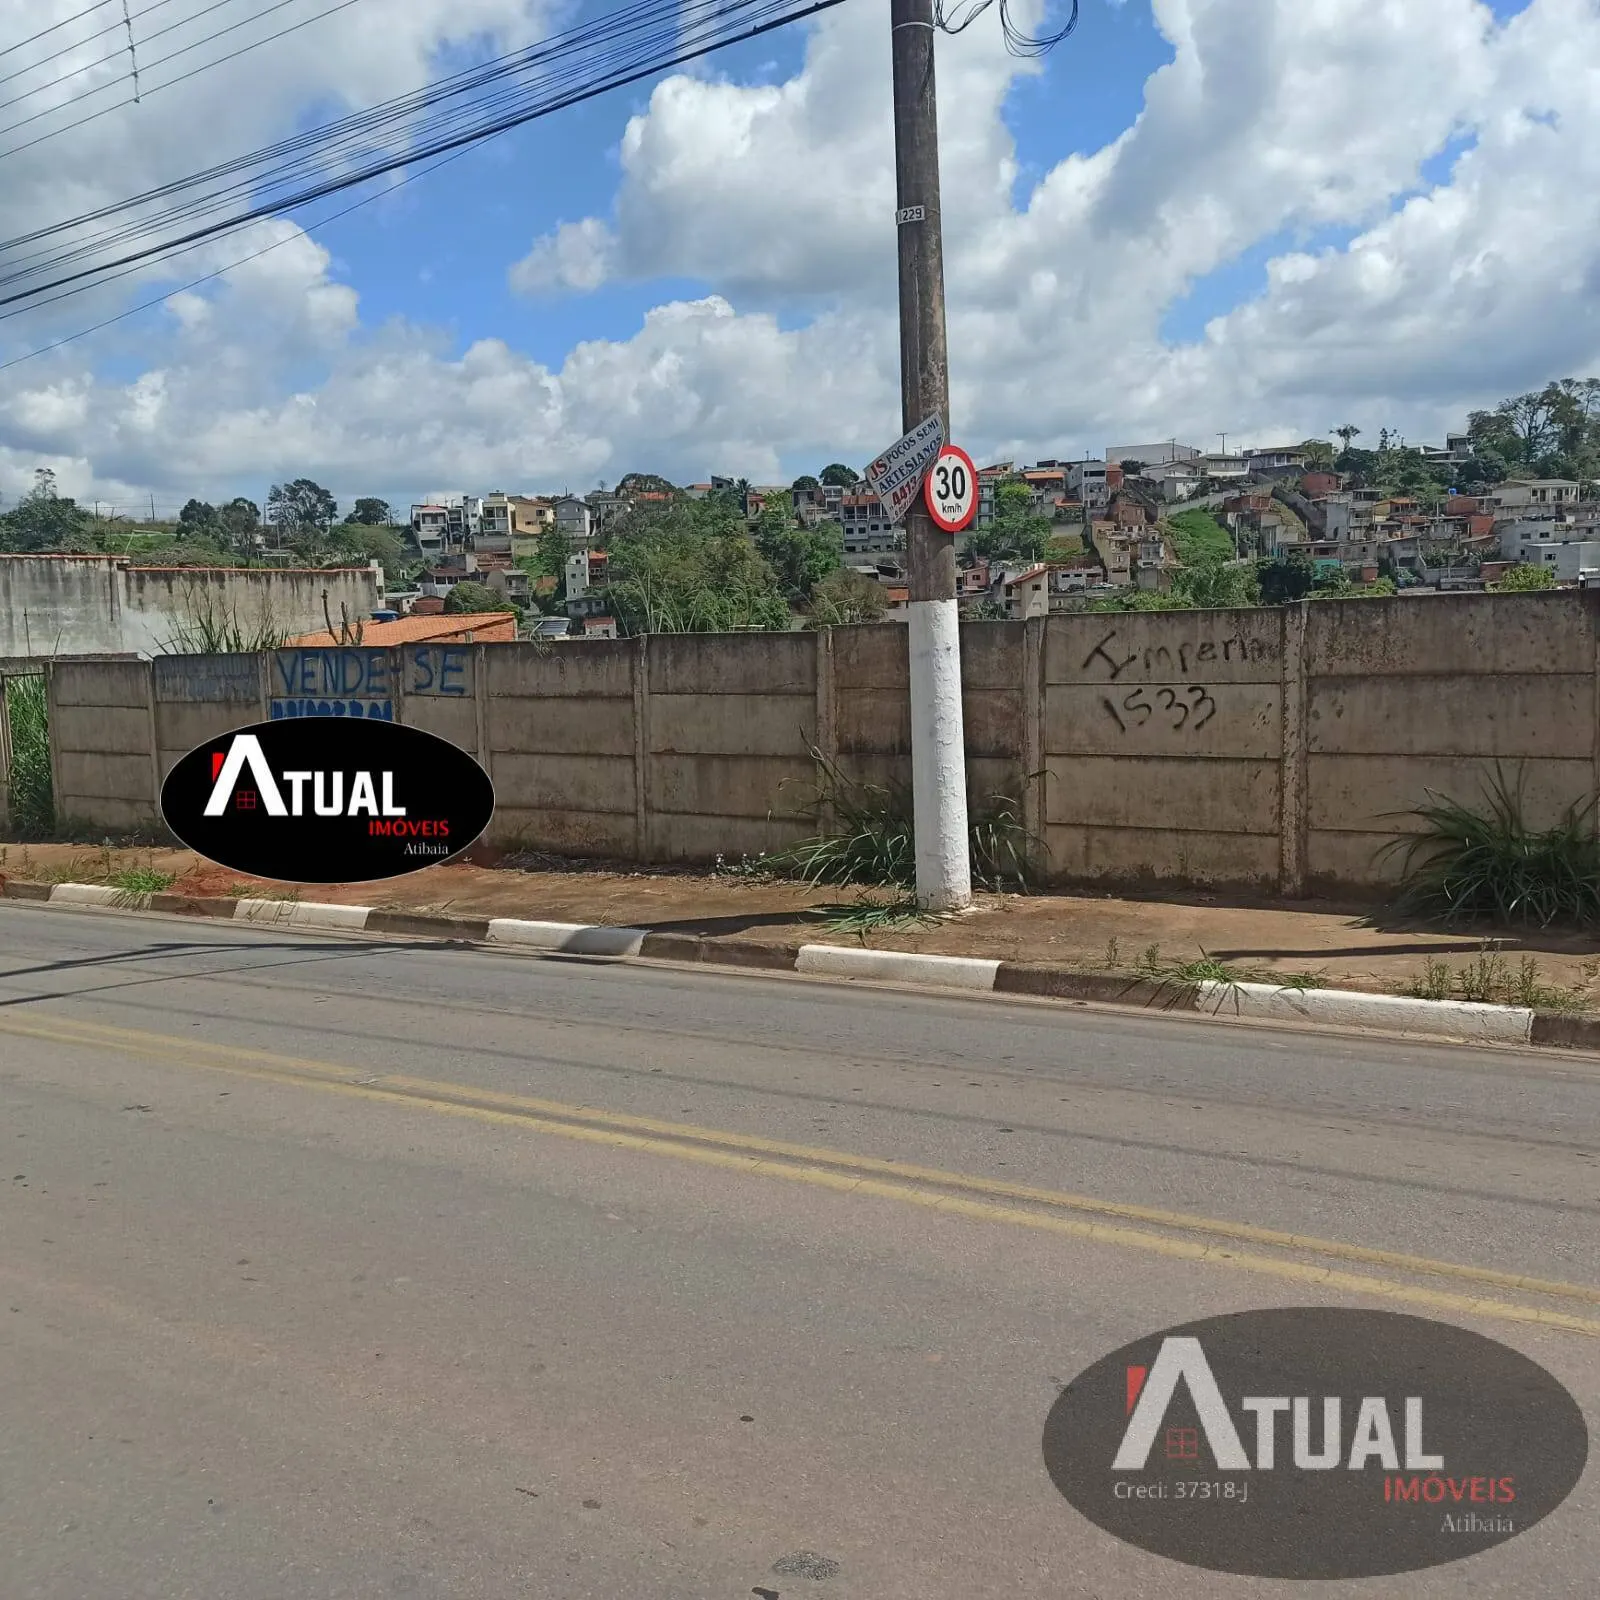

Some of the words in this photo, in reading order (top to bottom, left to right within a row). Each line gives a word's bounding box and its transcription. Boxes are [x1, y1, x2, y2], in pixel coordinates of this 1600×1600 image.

[869, 458, 892, 481] JS
[885, 436, 917, 464] POÇOS
[916, 418, 940, 441] SEMI
[879, 433, 942, 493] ARTESIANOS
[935, 465, 966, 501] 30
[941, 502, 962, 514] km/h
[1102, 686, 1217, 732] 1533
